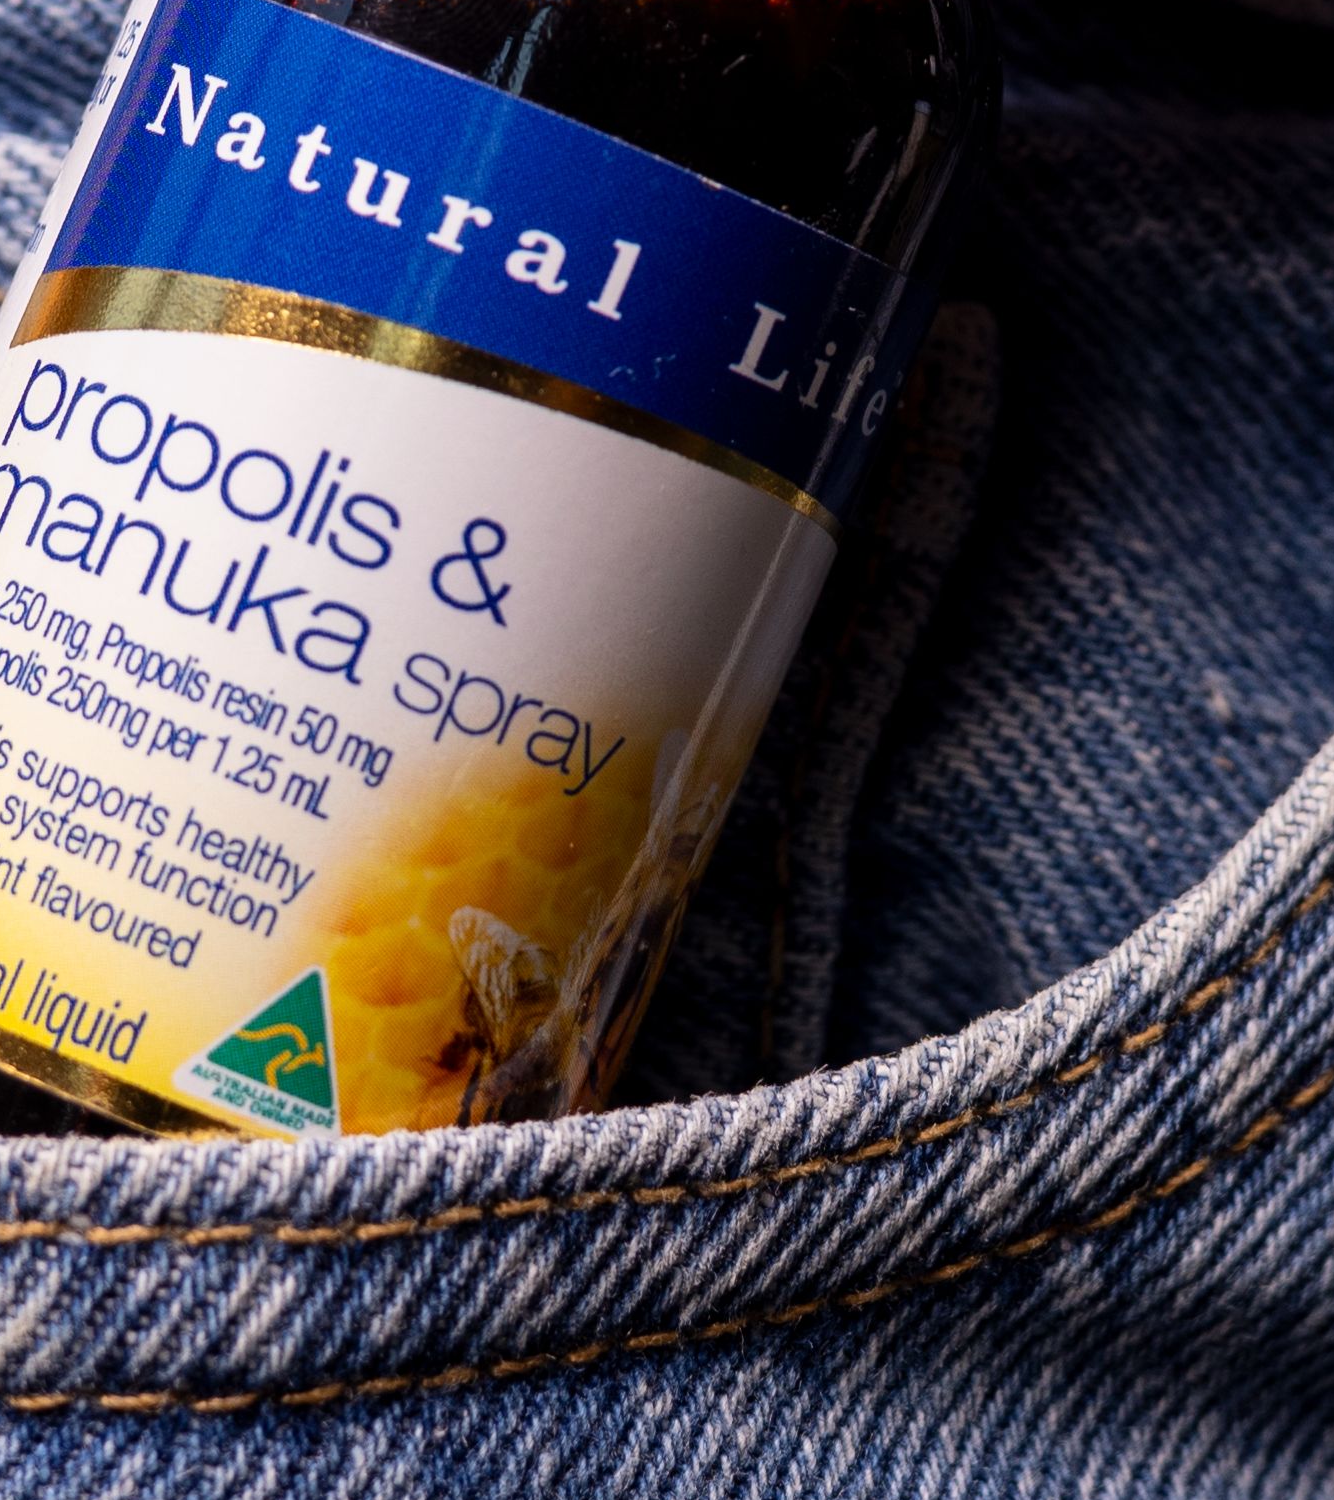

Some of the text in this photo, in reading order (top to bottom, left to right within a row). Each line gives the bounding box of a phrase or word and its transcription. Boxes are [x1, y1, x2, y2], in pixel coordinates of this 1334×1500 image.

[145, 62, 888, 437] Natural Life
[1, 358, 513, 626] propolis &
[43, 609, 91, 660] mg,
[97, 623, 211, 703] Propolis
[216, 679, 287, 736] resin
[291, 706, 338, 754] 50
[338, 732, 394, 787] mg
[46, 667, 151, 748] 250mg
[147, 716, 209, 762] per
[213, 735, 284, 794] 1.25
[281, 772, 333, 820] mL
[393, 651, 627, 797] spray
[17, 749, 171, 838] supports
[176, 807, 316, 902] healthy
[128, 841, 279, 936] function
[30, 866, 202, 969] flavoured
[22, 968, 148, 1064] liquid
[190, 1063, 335, 1129] AUSTRALIAN MADE
[212, 1085, 306, 1130] AND OWNED
